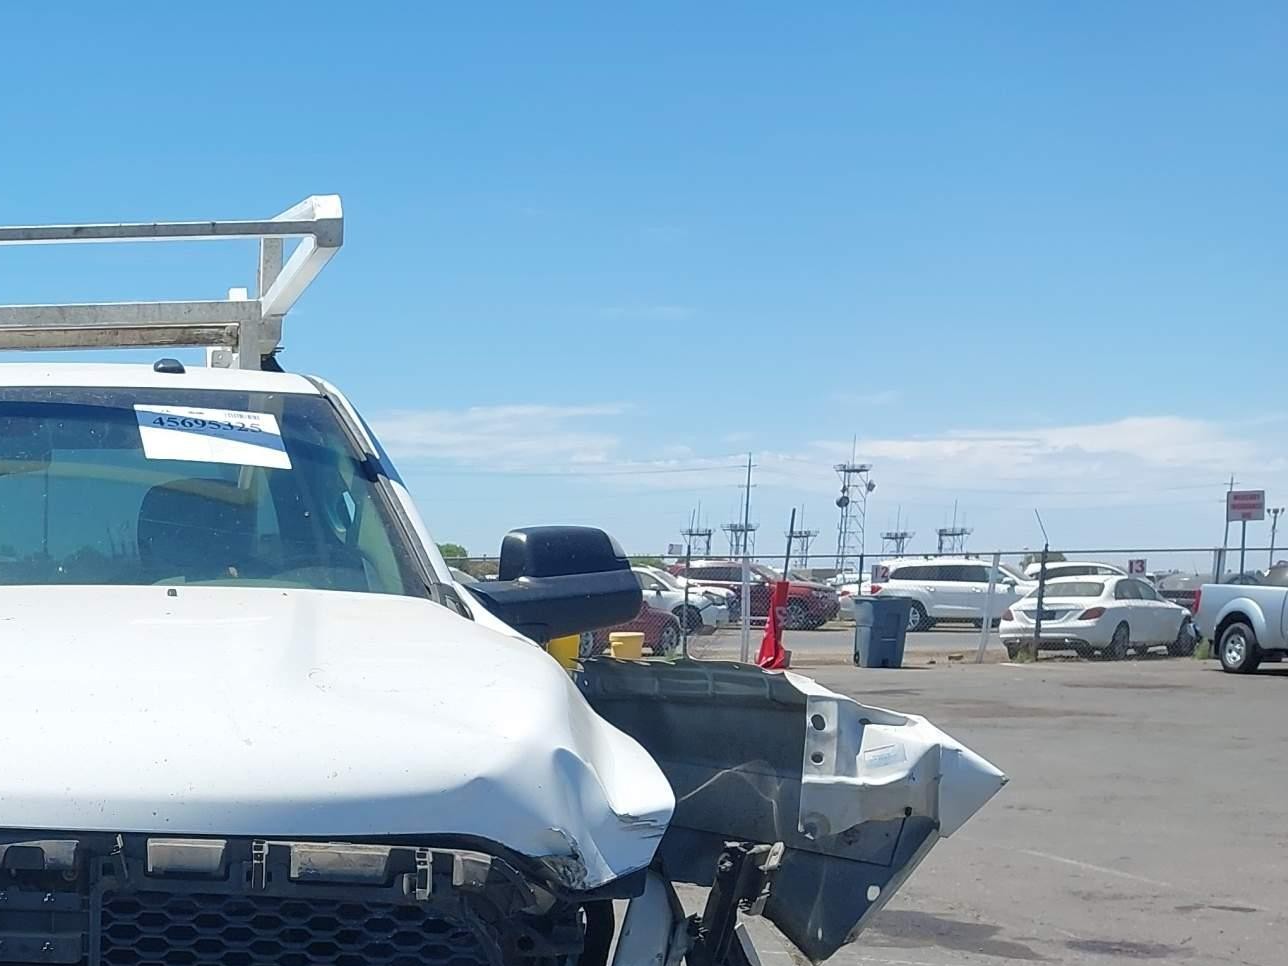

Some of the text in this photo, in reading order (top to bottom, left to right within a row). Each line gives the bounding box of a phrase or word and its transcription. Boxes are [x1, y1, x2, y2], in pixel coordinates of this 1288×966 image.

[152, 416, 263, 433] 45695325
[875, 566, 890, 578] 12
[1129, 560, 1145, 574] 13
